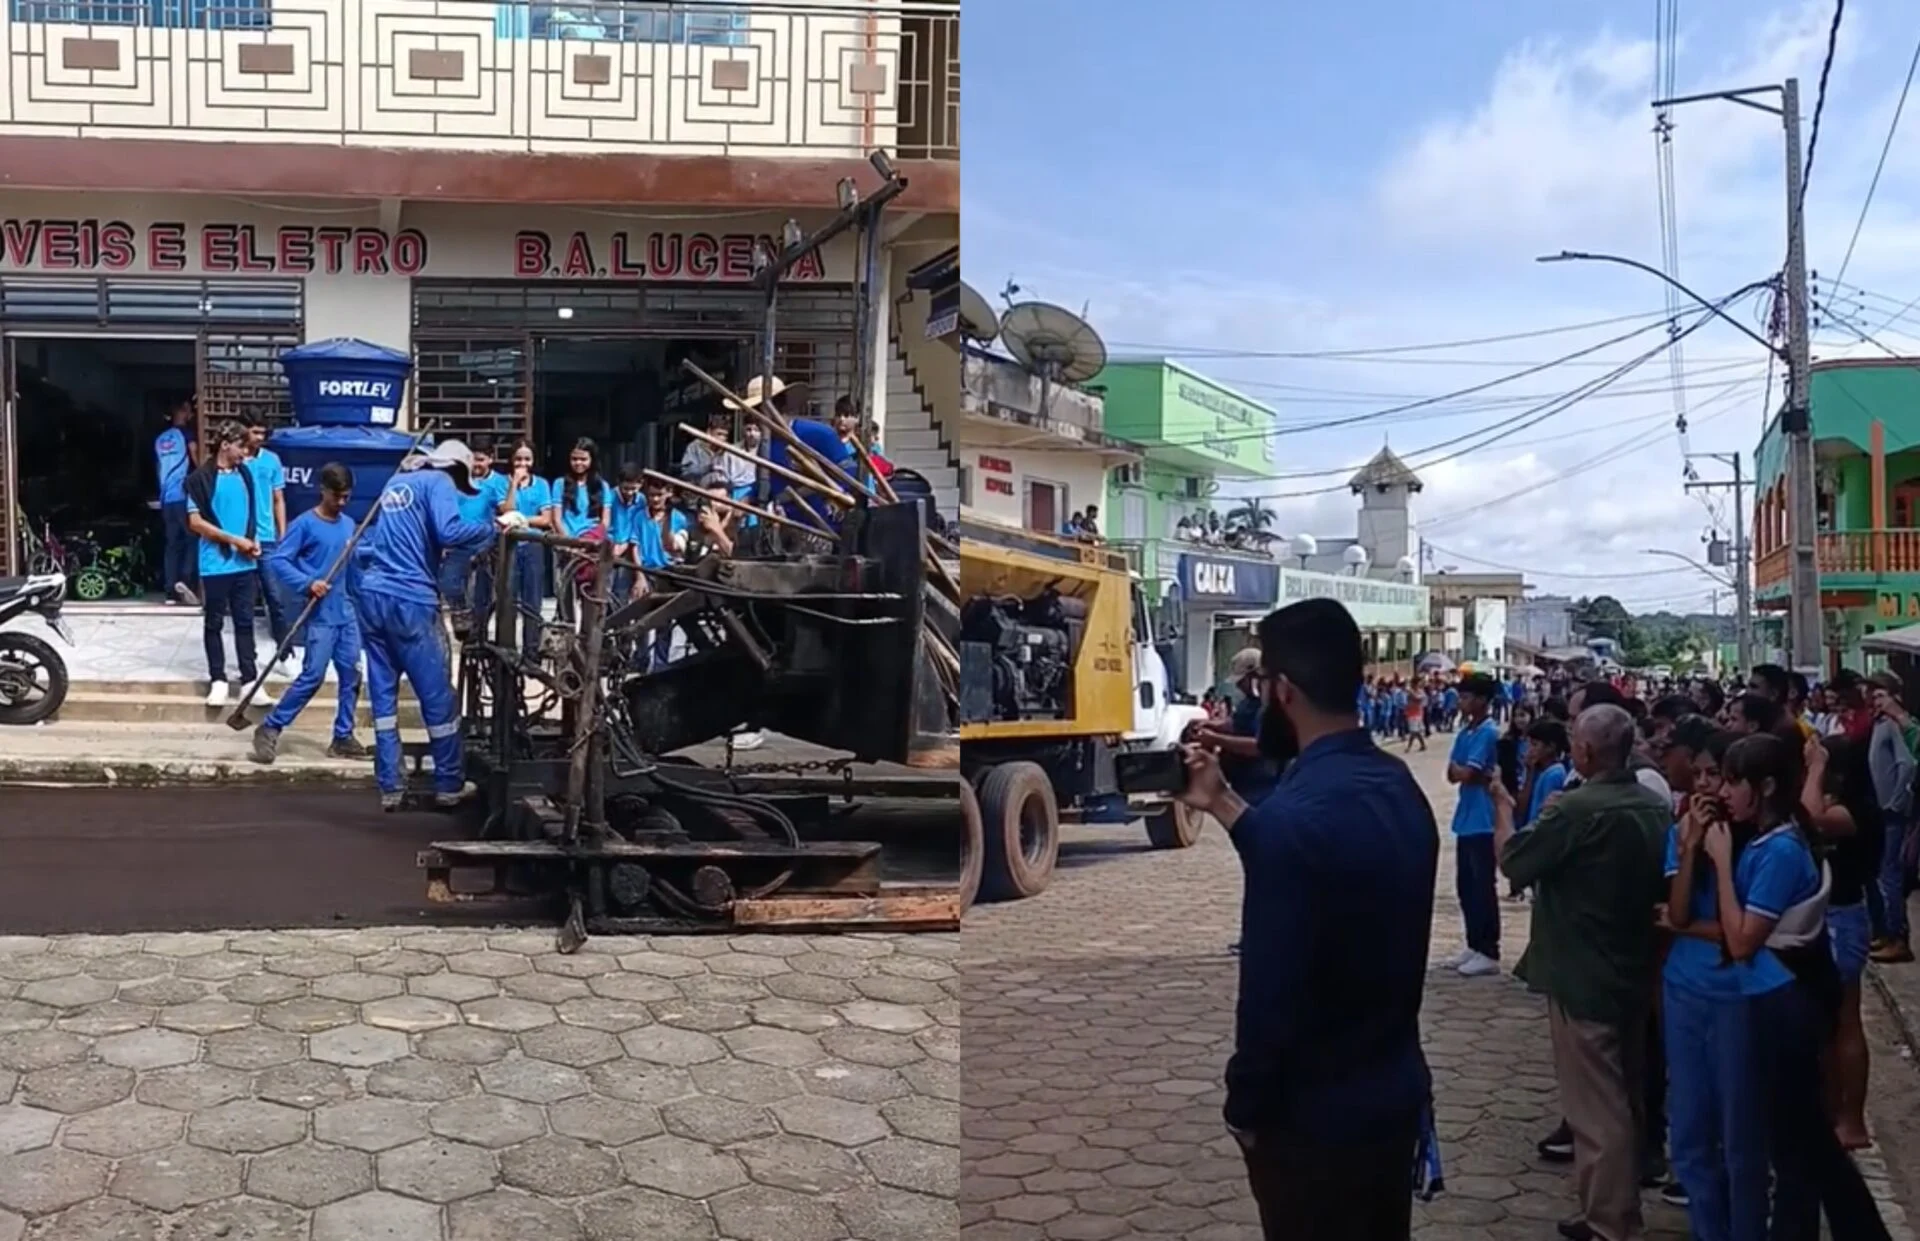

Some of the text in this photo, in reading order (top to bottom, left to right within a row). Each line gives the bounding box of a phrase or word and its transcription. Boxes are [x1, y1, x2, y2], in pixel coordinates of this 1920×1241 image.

[0, 219, 428, 275] VEIS E ELETRO
[319, 380, 392, 399] FORTLEV
[1194, 561, 1236, 595] CAIXA
